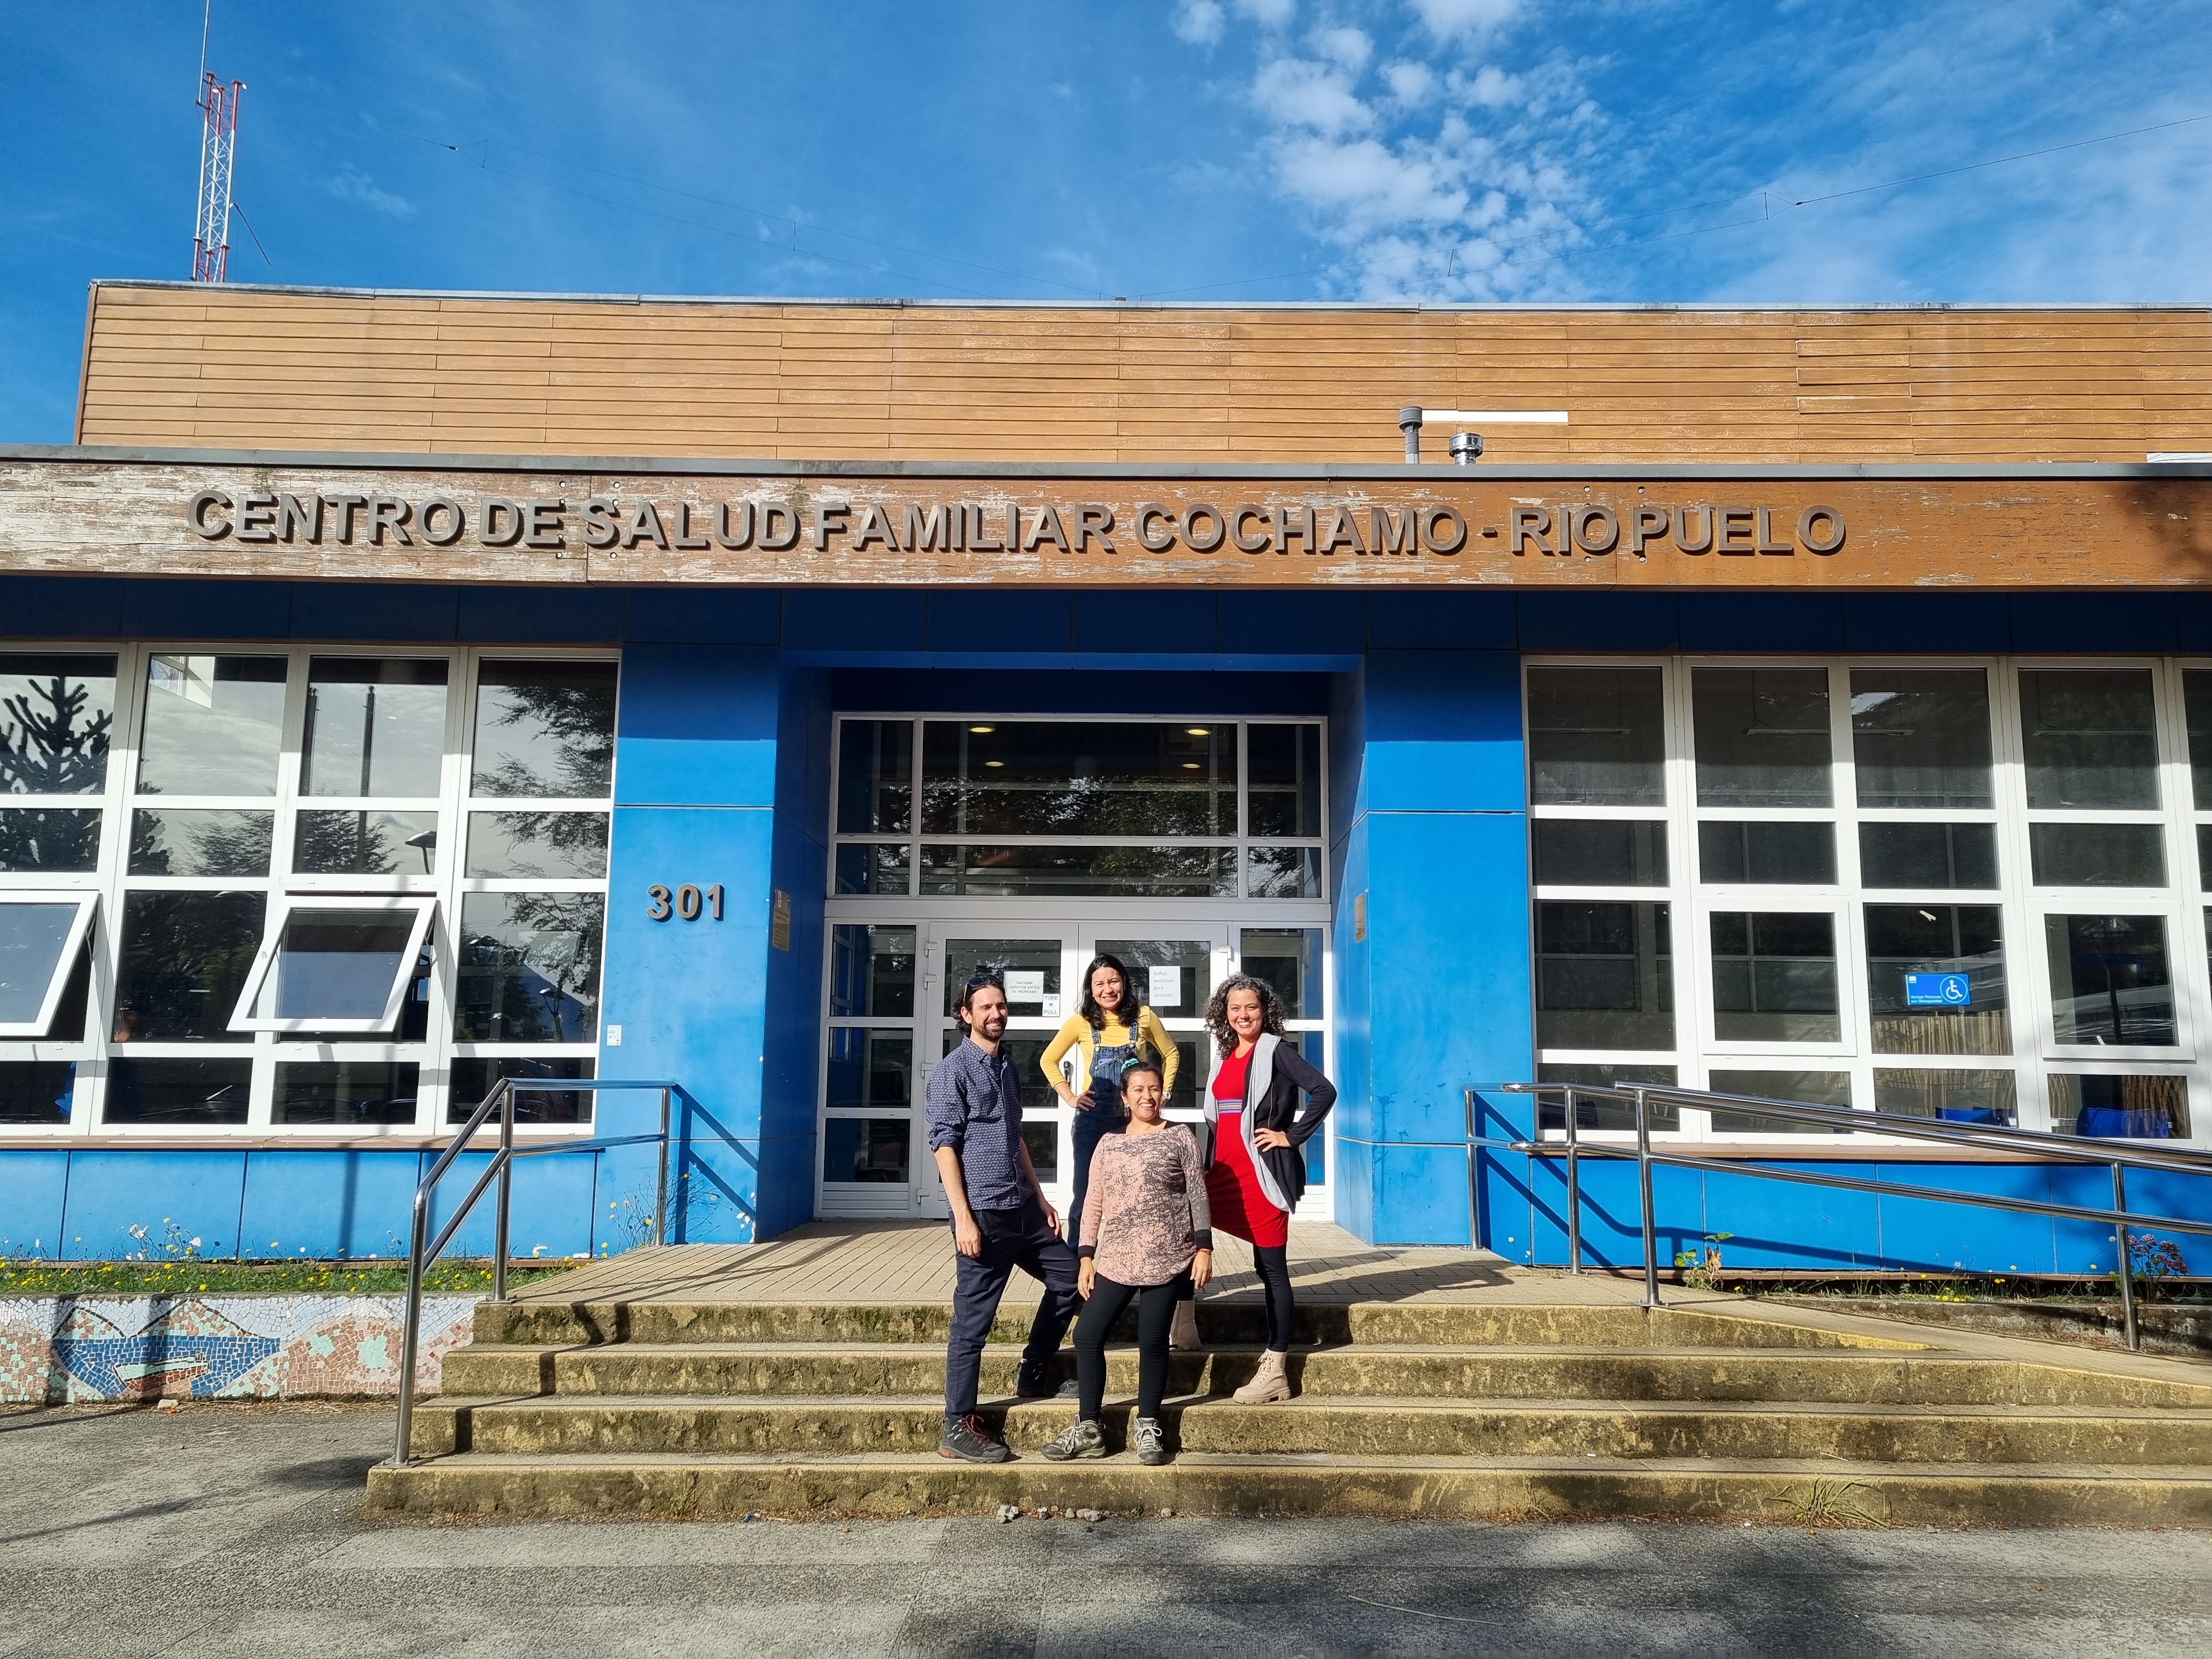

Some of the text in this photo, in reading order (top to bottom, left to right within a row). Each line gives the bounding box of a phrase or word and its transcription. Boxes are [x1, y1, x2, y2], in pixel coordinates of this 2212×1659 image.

[188, 490, 465, 546] CENTRO
[479, 497, 565, 549] DE
[579, 498, 800, 551] SALUD
[813, 501, 1118, 554] FAMILIAR
[1135, 503, 1468, 556] COCHAMO
[1511, 504, 1619, 557] RIO
[1632, 503, 1847, 556] PUELO
[646, 884, 725, 923] 301
